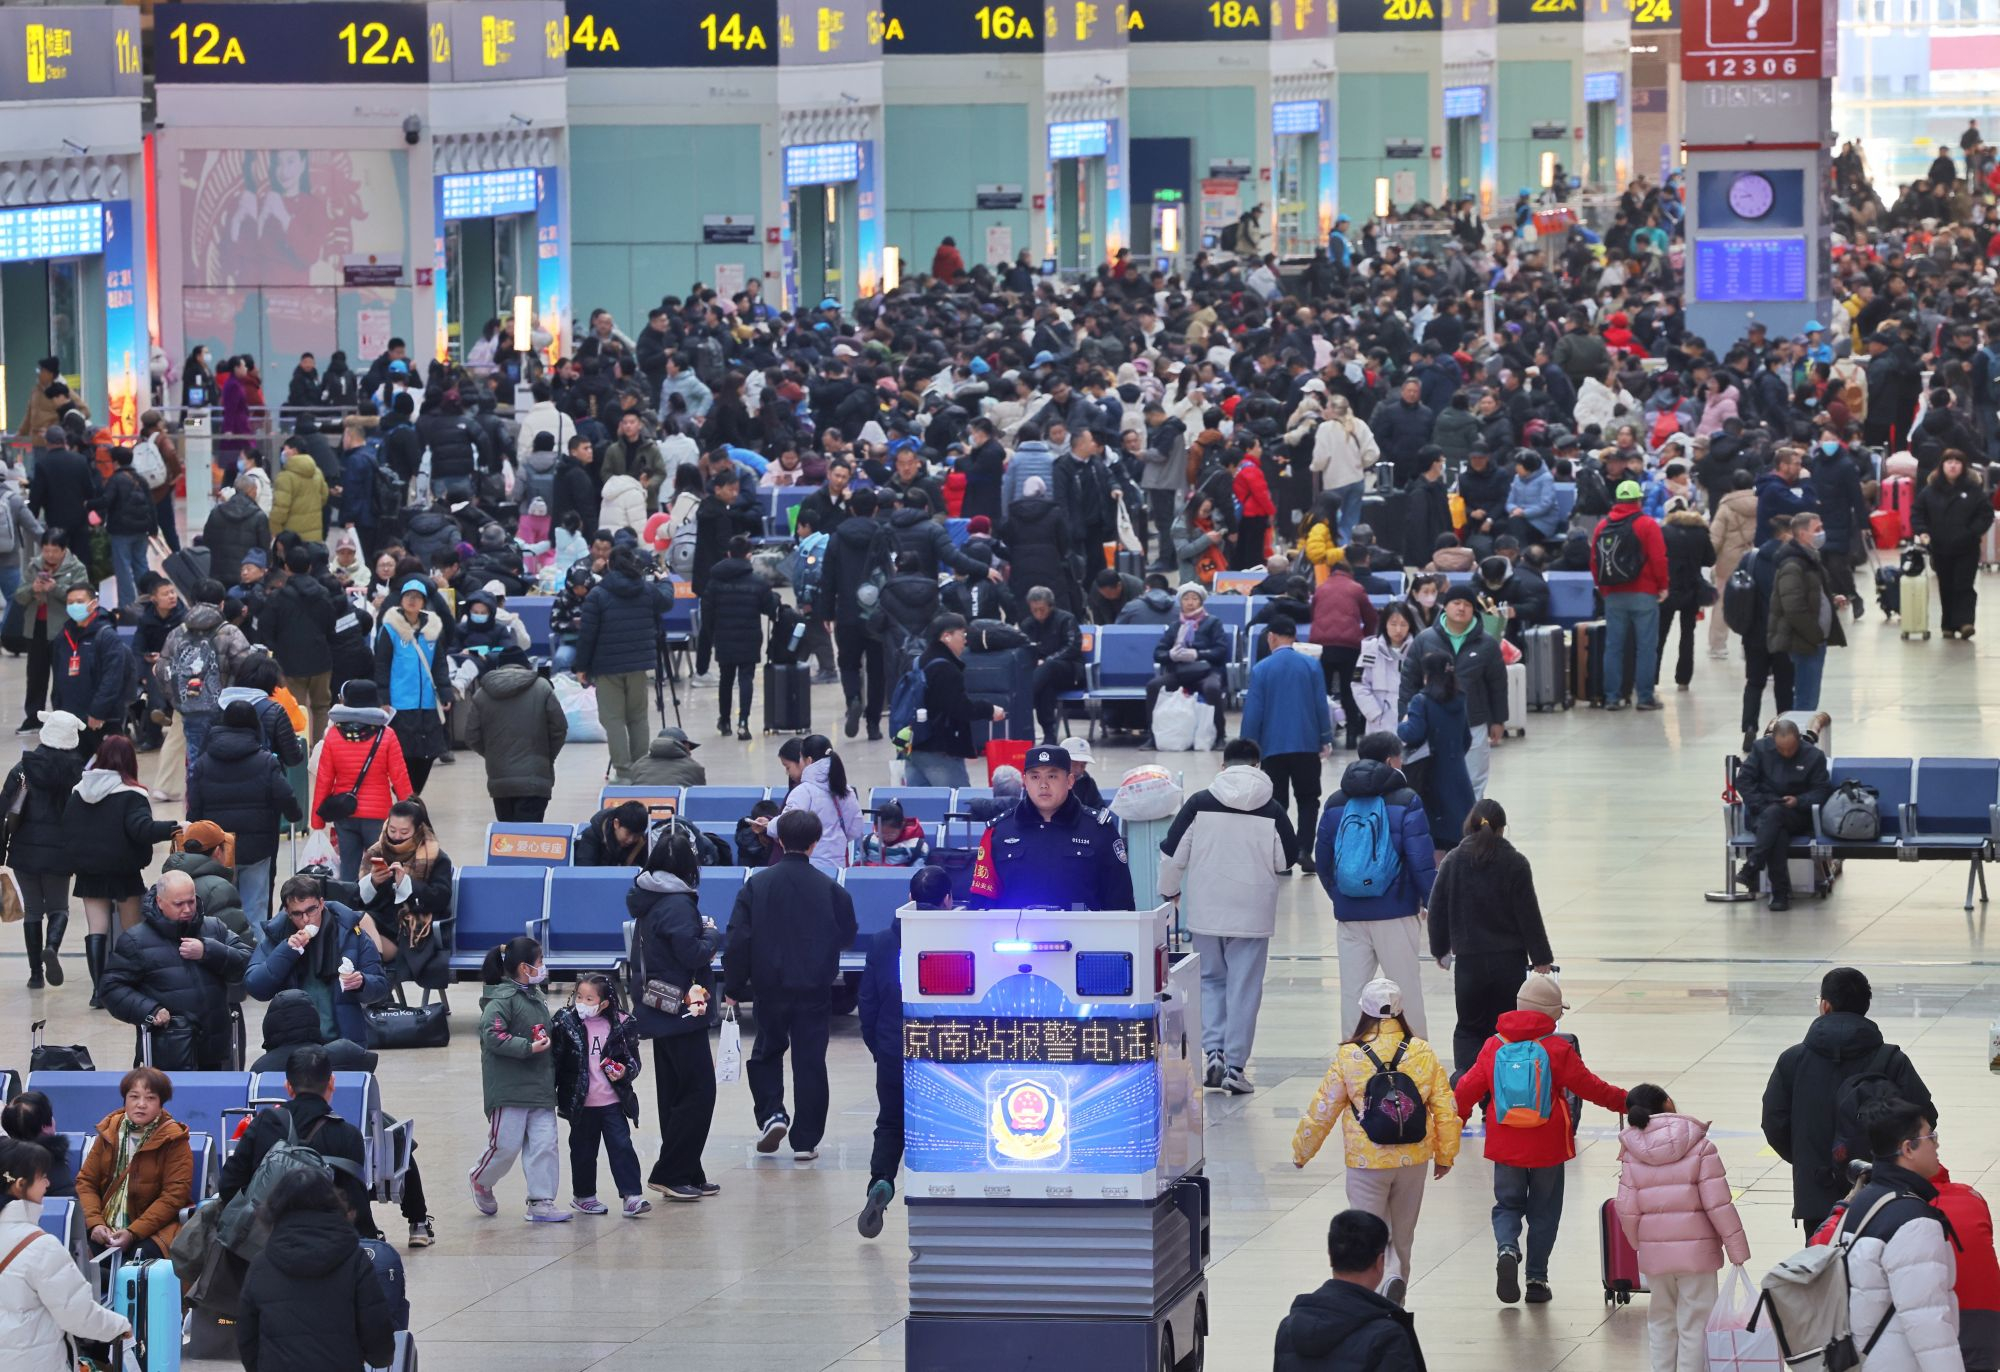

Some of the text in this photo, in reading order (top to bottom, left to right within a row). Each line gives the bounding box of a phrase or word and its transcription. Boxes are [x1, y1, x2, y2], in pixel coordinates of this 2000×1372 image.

[975, 6, 1034, 39] 16A
[1208, 1, 1260, 27] 18A
[1383, 0, 1434, 20] 20A
[170, 22, 246, 65] 12A
[338, 22, 415, 65] 12A
[700, 13, 767, 50] 14A
[116, 29, 140, 74] 11A
[1706, 58, 1797, 76] 12306
[516, 840, 562, 855] 爱心专座
